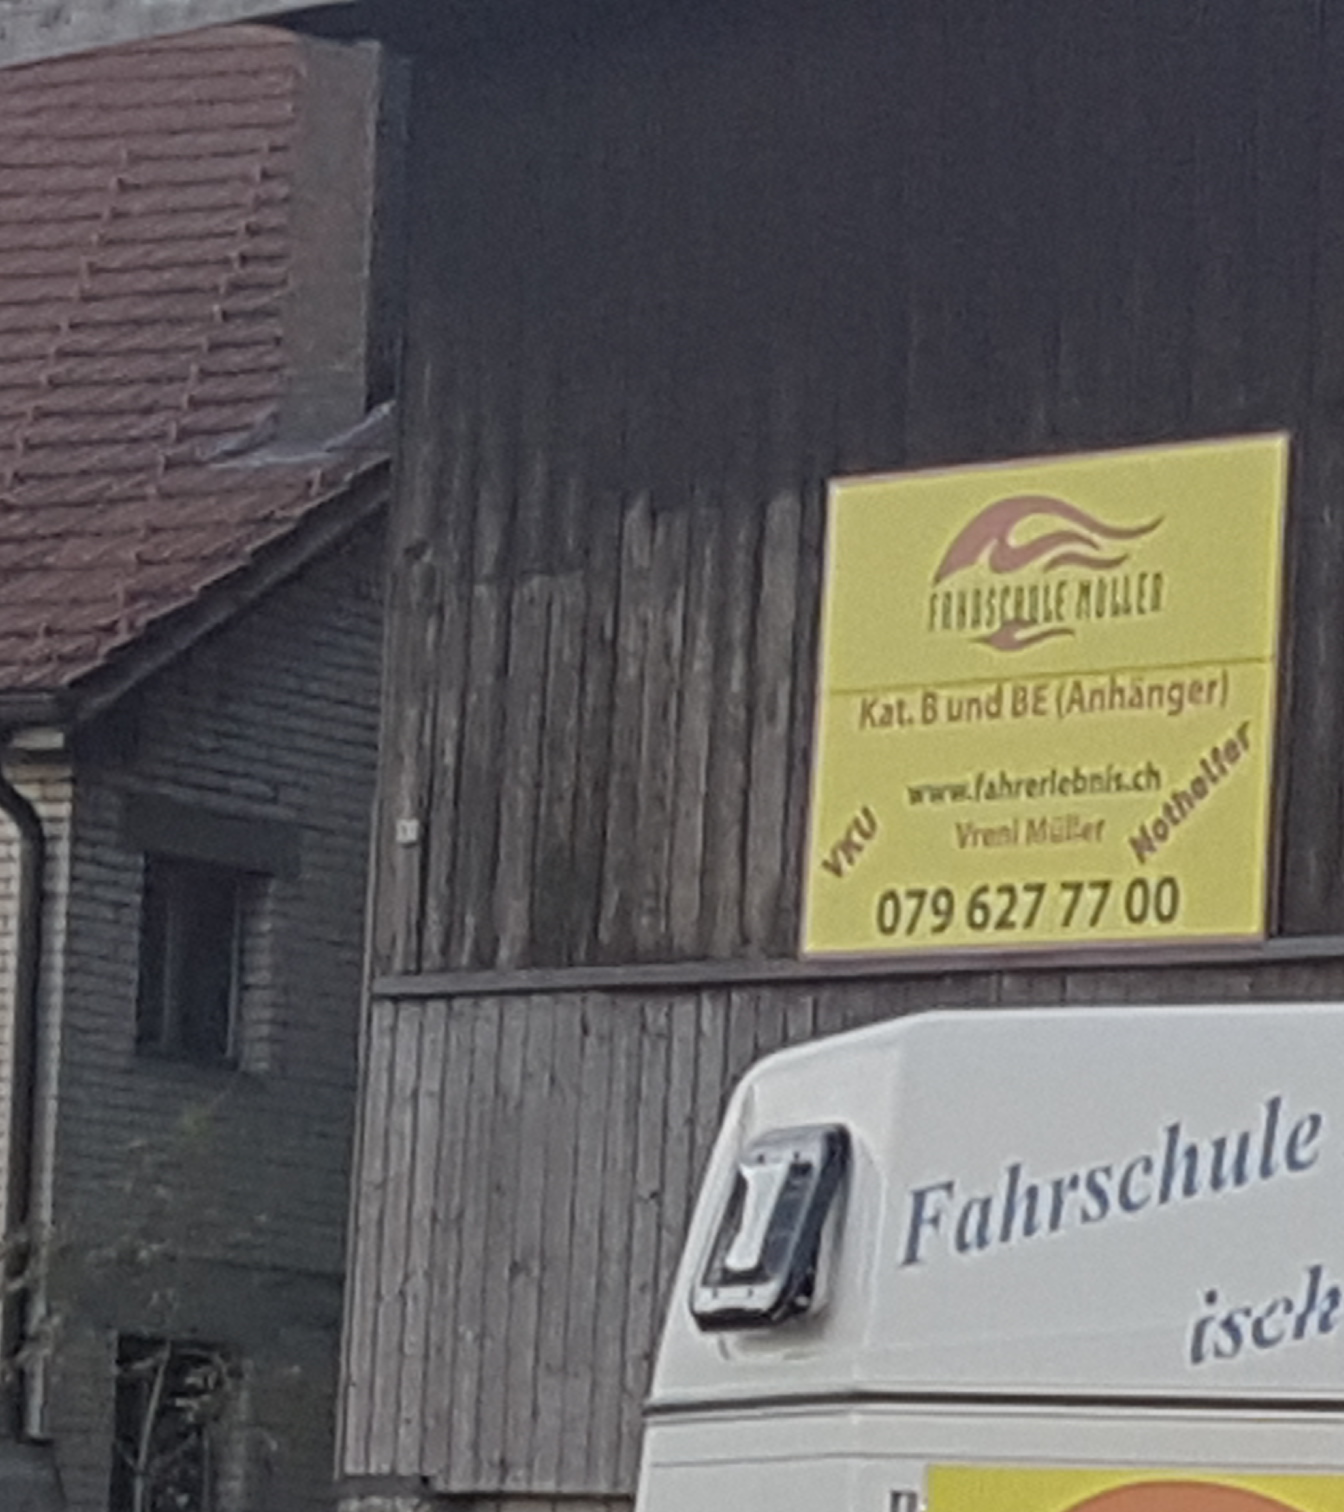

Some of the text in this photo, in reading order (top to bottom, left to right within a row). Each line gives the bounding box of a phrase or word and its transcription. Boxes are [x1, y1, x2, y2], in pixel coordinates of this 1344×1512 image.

[859, 669, 1229, 730] Kat. B und BE (Anhänger)
[908, 760, 1162, 806] www.fahrerlebnis.ch
[820, 806, 879, 879] VKU
[956, 813, 1107, 850] Vreni Müller
[876, 875, 1180, 937] 079 627 77 00
[899, 1093, 1324, 1268] Fahrschule
[1188, 1263, 1344, 1367] isch
